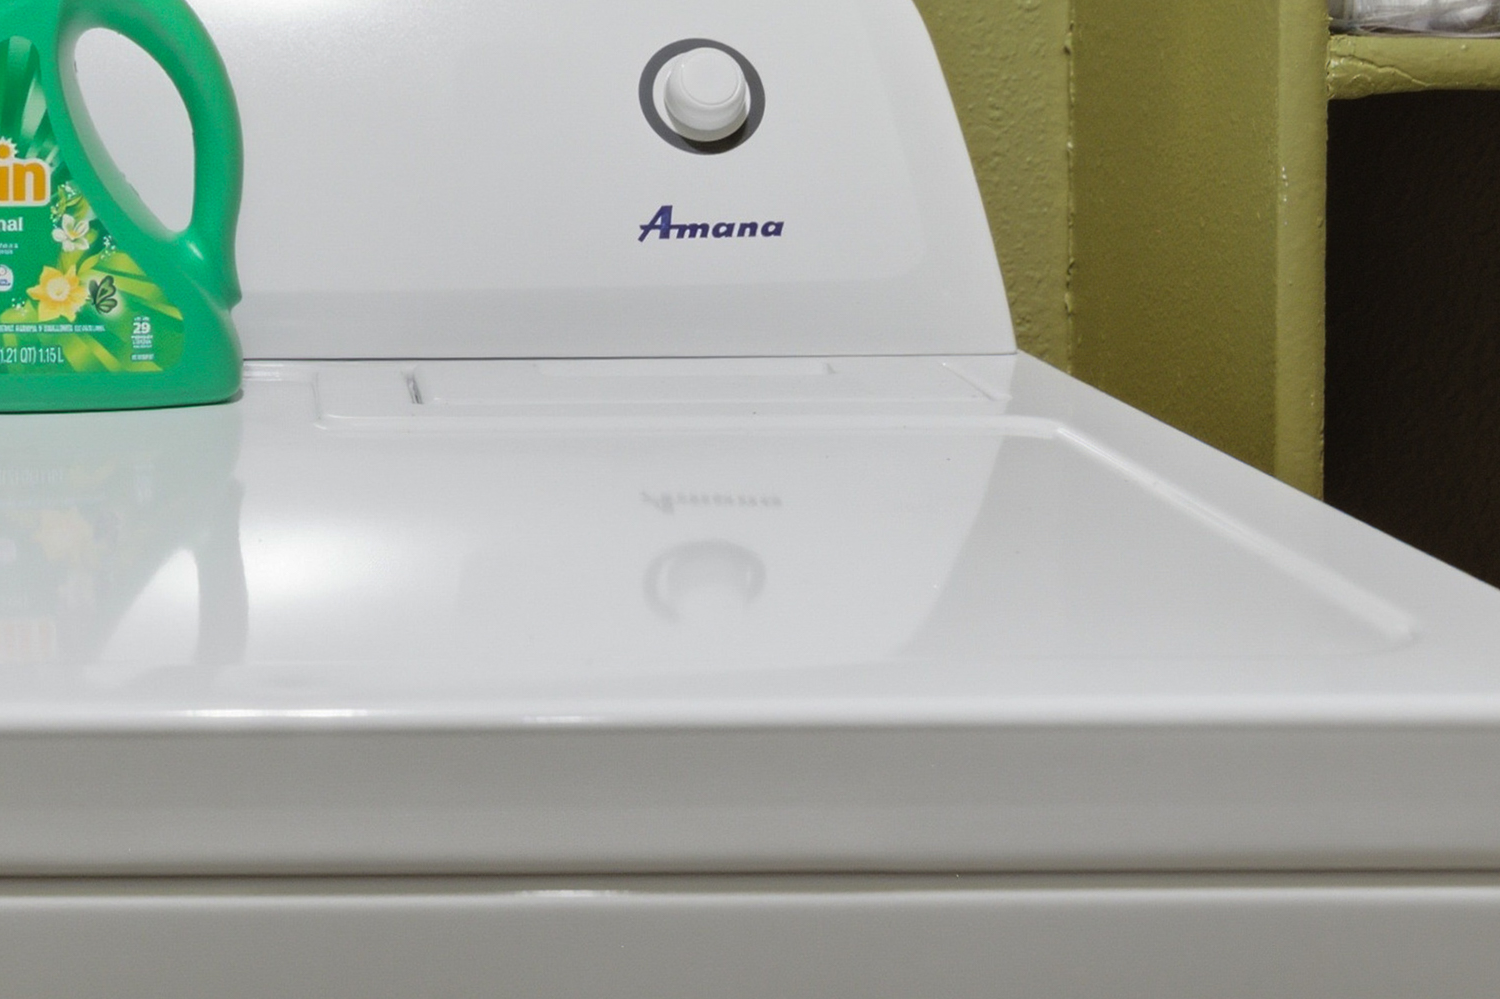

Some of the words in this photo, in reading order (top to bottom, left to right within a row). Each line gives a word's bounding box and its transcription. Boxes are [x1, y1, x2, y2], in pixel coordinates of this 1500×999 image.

[638, 205, 785, 243] Amana
[133, 322, 151, 335] 29
[20, 346, 36, 364] QT)
[38, 347, 57, 363] 1.15
[57, 347, 64, 363] L
